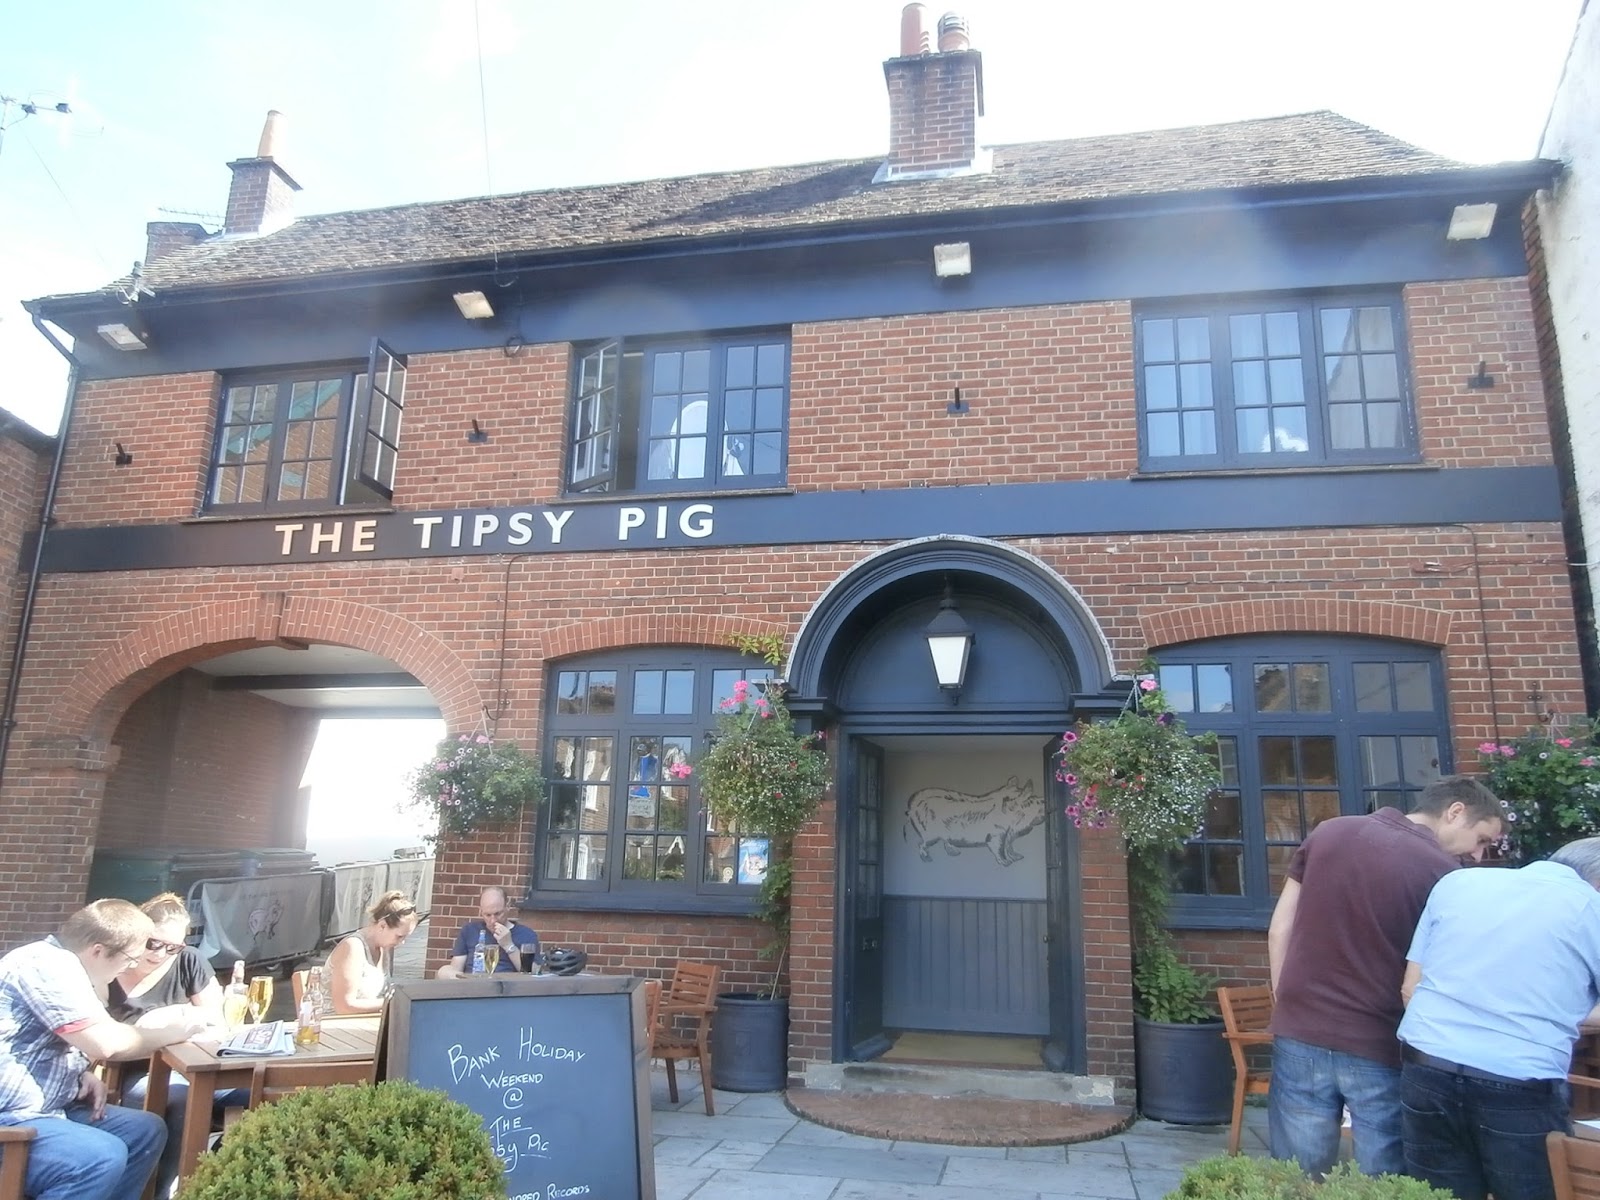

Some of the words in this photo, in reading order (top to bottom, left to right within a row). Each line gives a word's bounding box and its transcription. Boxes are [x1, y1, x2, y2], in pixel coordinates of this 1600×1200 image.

[275, 520, 377, 555] THE
[413, 510, 574, 549] TIPSY
[618, 504, 714, 541] PIG
[502, 1087, 524, 1110] @
